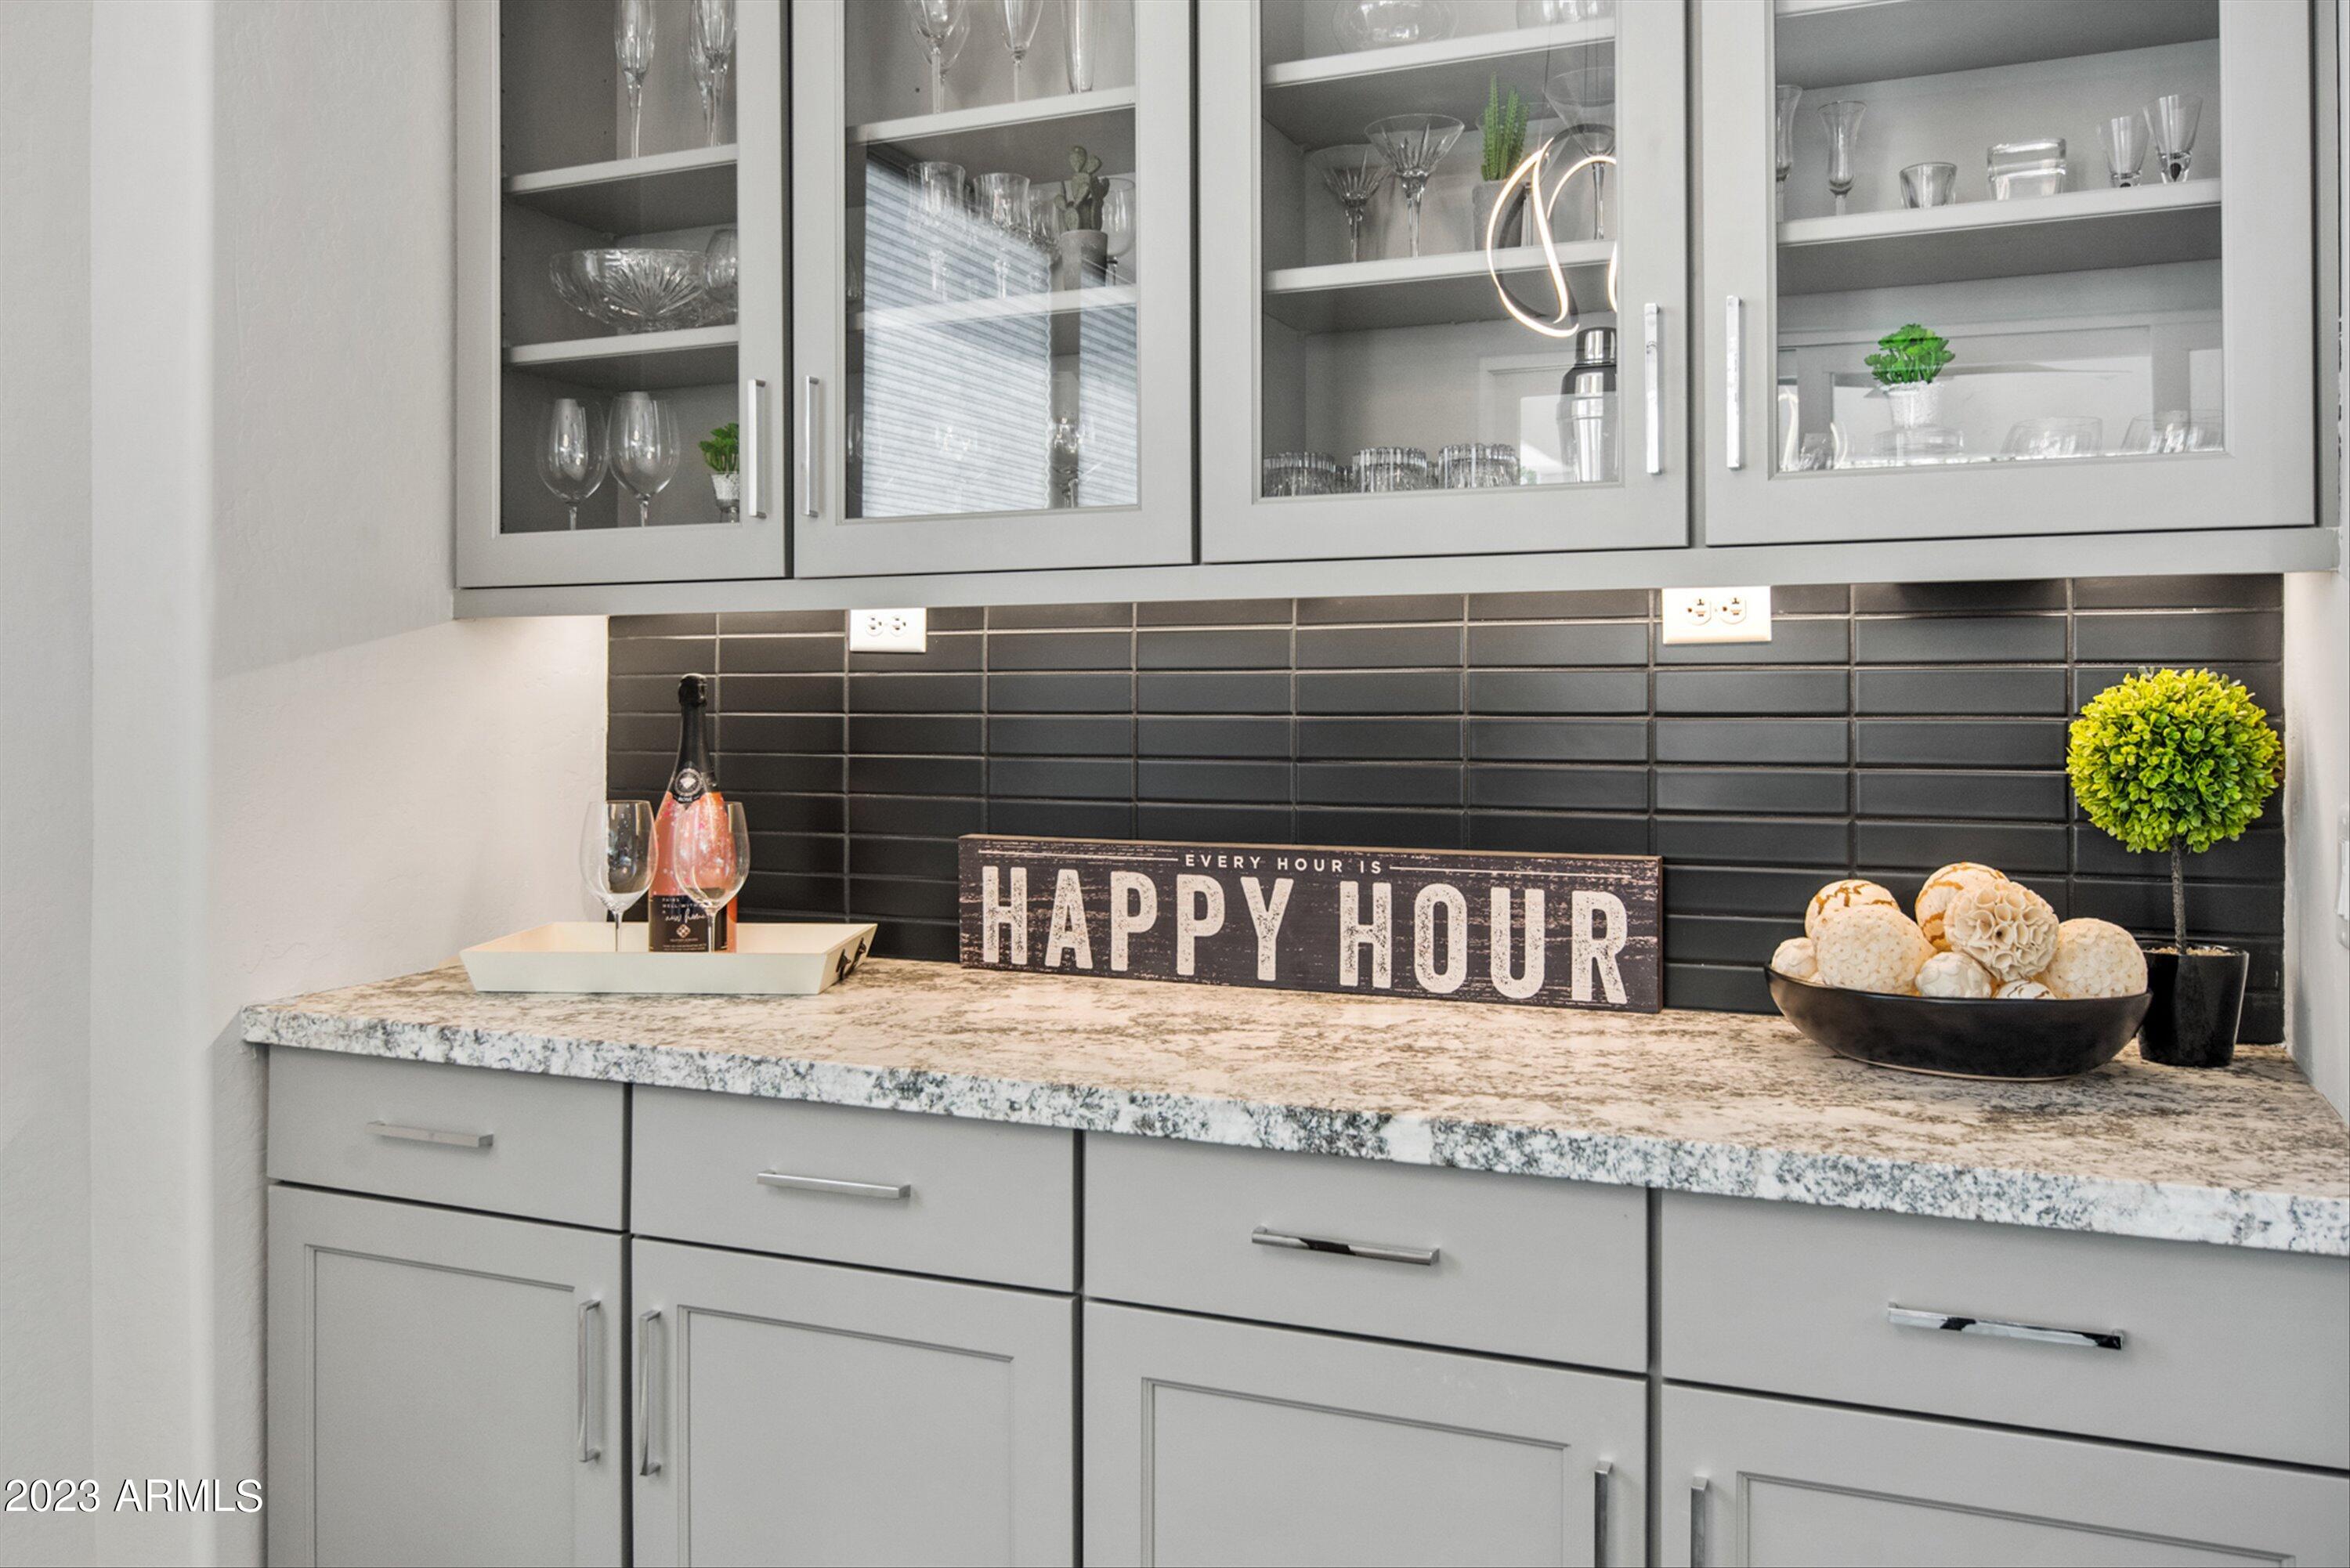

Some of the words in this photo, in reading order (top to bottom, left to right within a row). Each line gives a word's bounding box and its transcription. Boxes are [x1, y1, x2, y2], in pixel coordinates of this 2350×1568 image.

[1185, 854, 1260, 869] EVERY
[1278, 858, 1343, 873] HOUR
[1360, 861, 1381, 874] IS
[982, 866, 1294, 981] HAPPY
[1340, 880, 1628, 1004] HOUR
